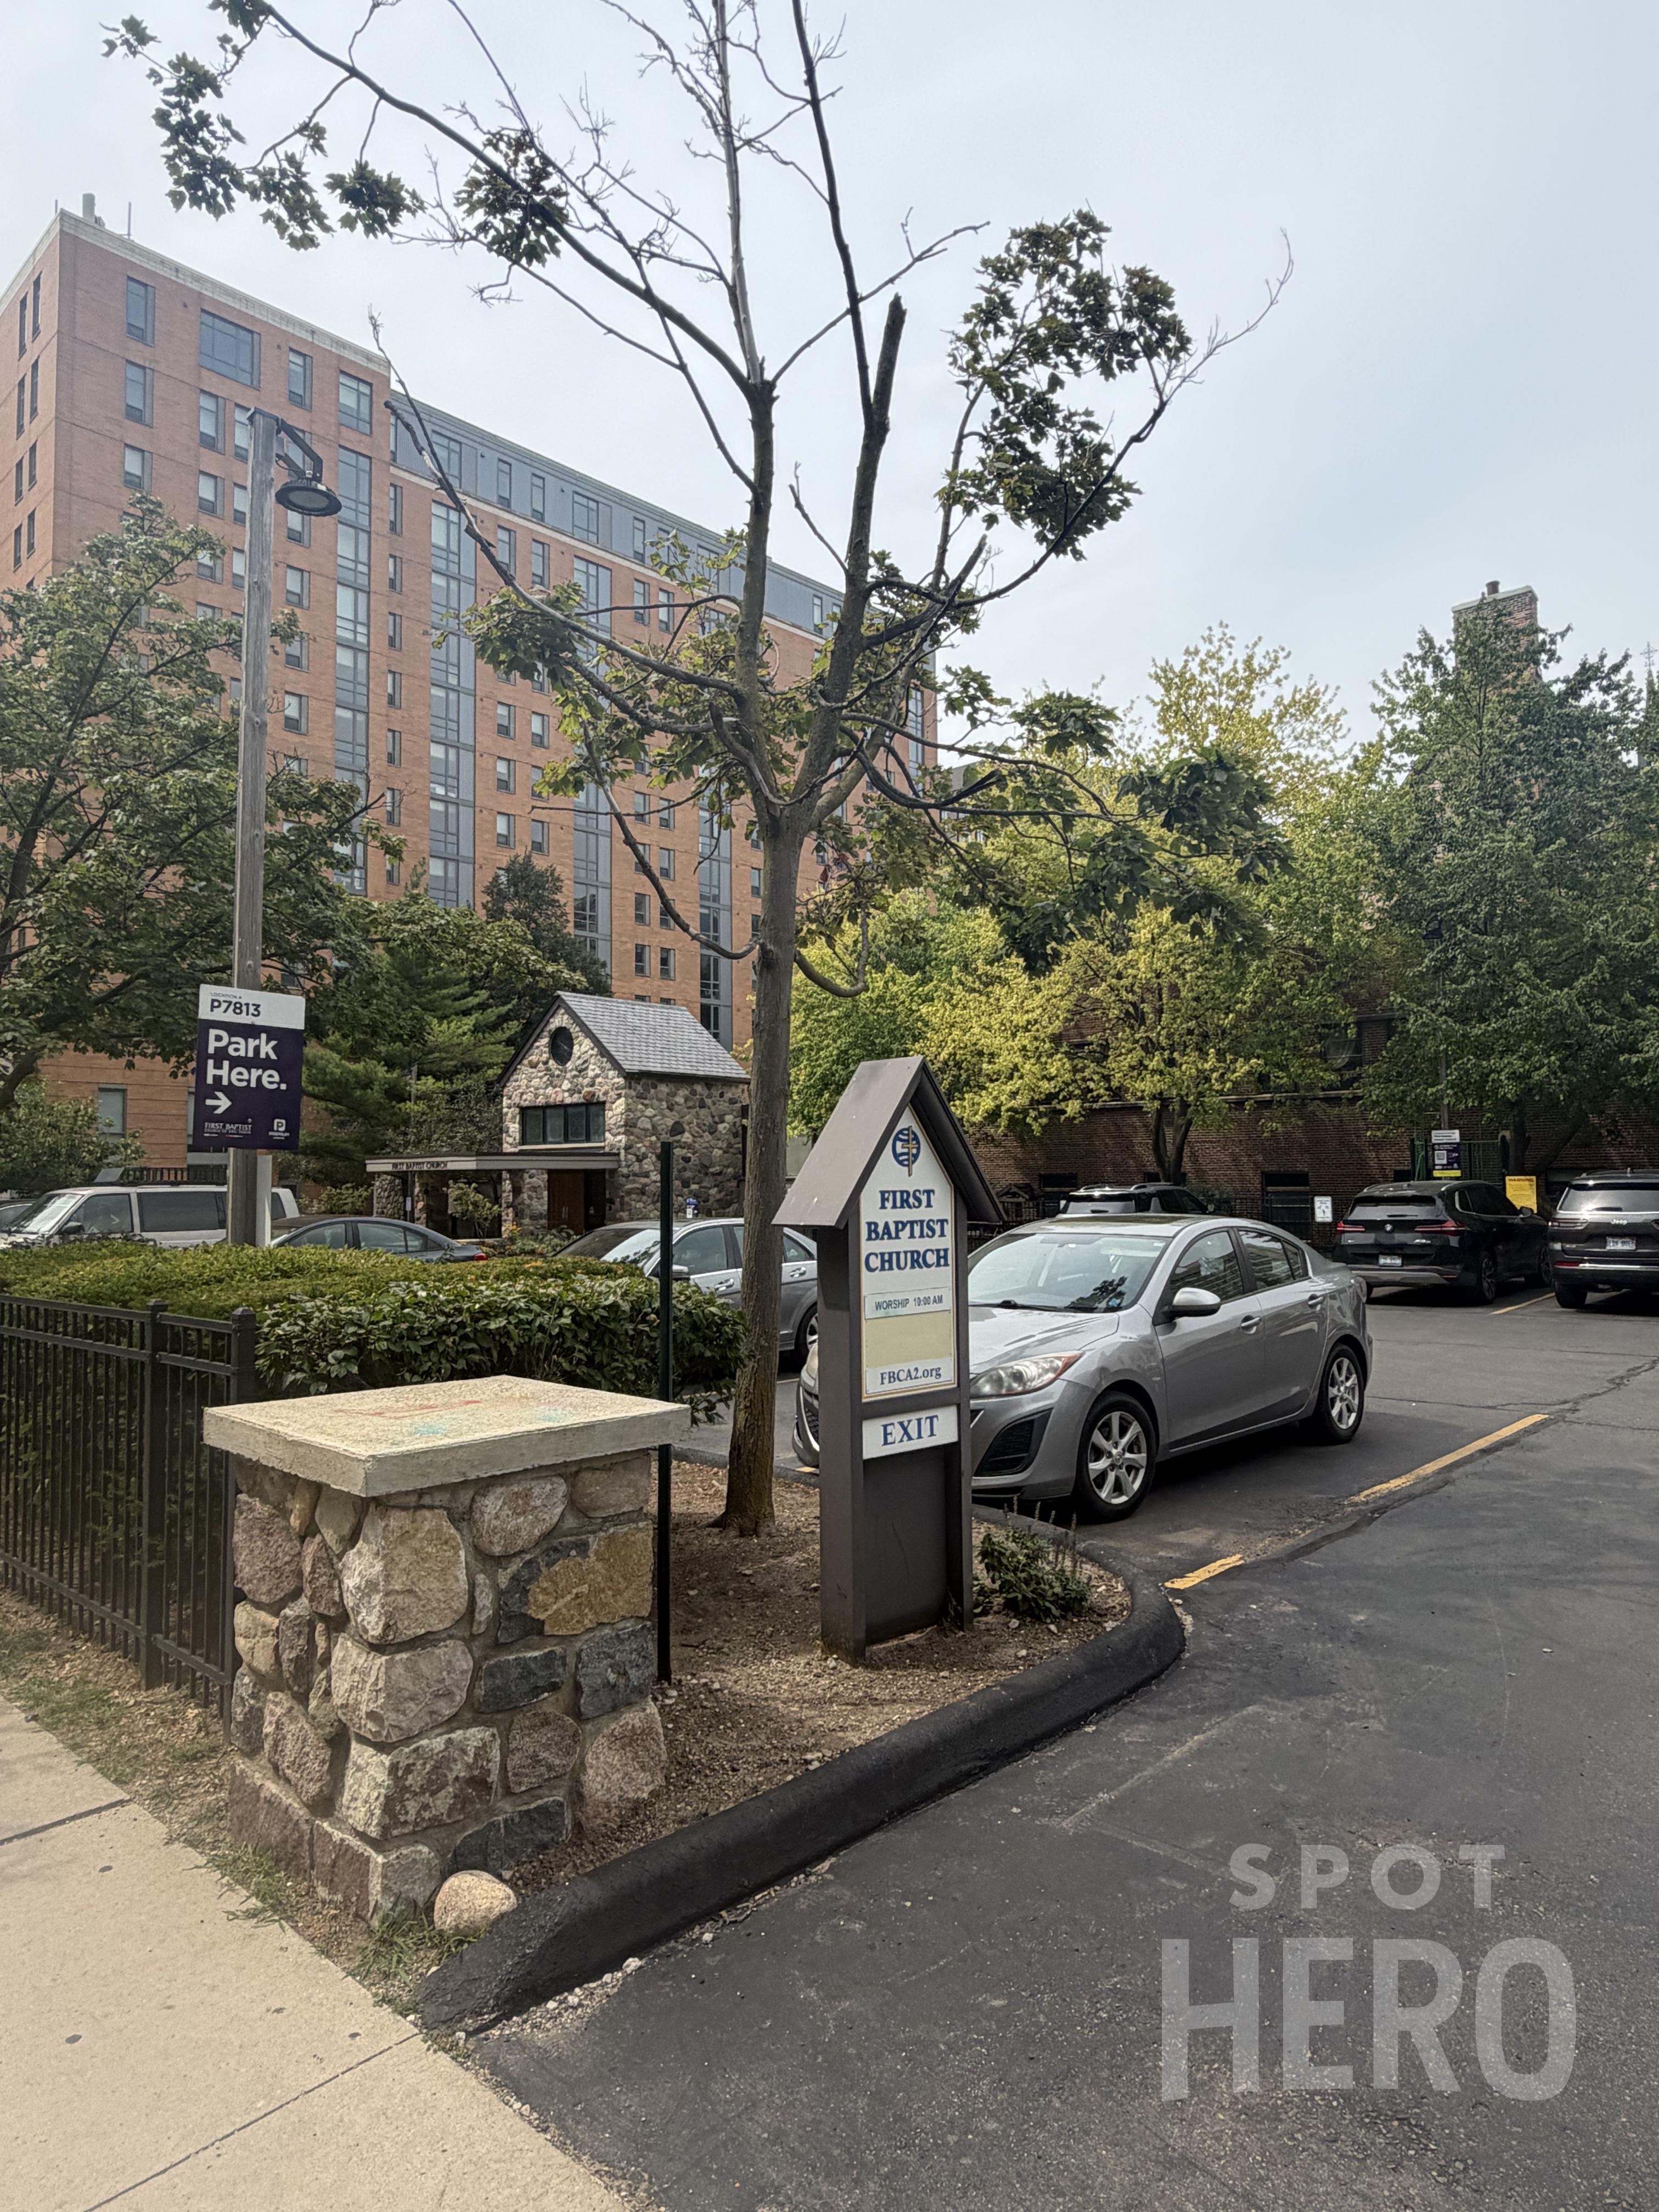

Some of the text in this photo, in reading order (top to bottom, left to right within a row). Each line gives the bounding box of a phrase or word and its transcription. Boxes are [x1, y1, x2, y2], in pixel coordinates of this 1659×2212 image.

[210, 998, 261, 1017] P7813
[207, 1028, 278, 1060] Park
[206, 1059, 287, 1090] Here.
[879, 1189, 935, 1209] FIRST
[865, 1219, 948, 1241] BAPTIST
[864, 1248, 950, 1273] CHURCH
[875, 1294, 943, 1311] WORSHIP 10:00 AM
[880, 1367, 942, 1385] FBCA2.org
[880, 1415, 939, 1446] EXIT
